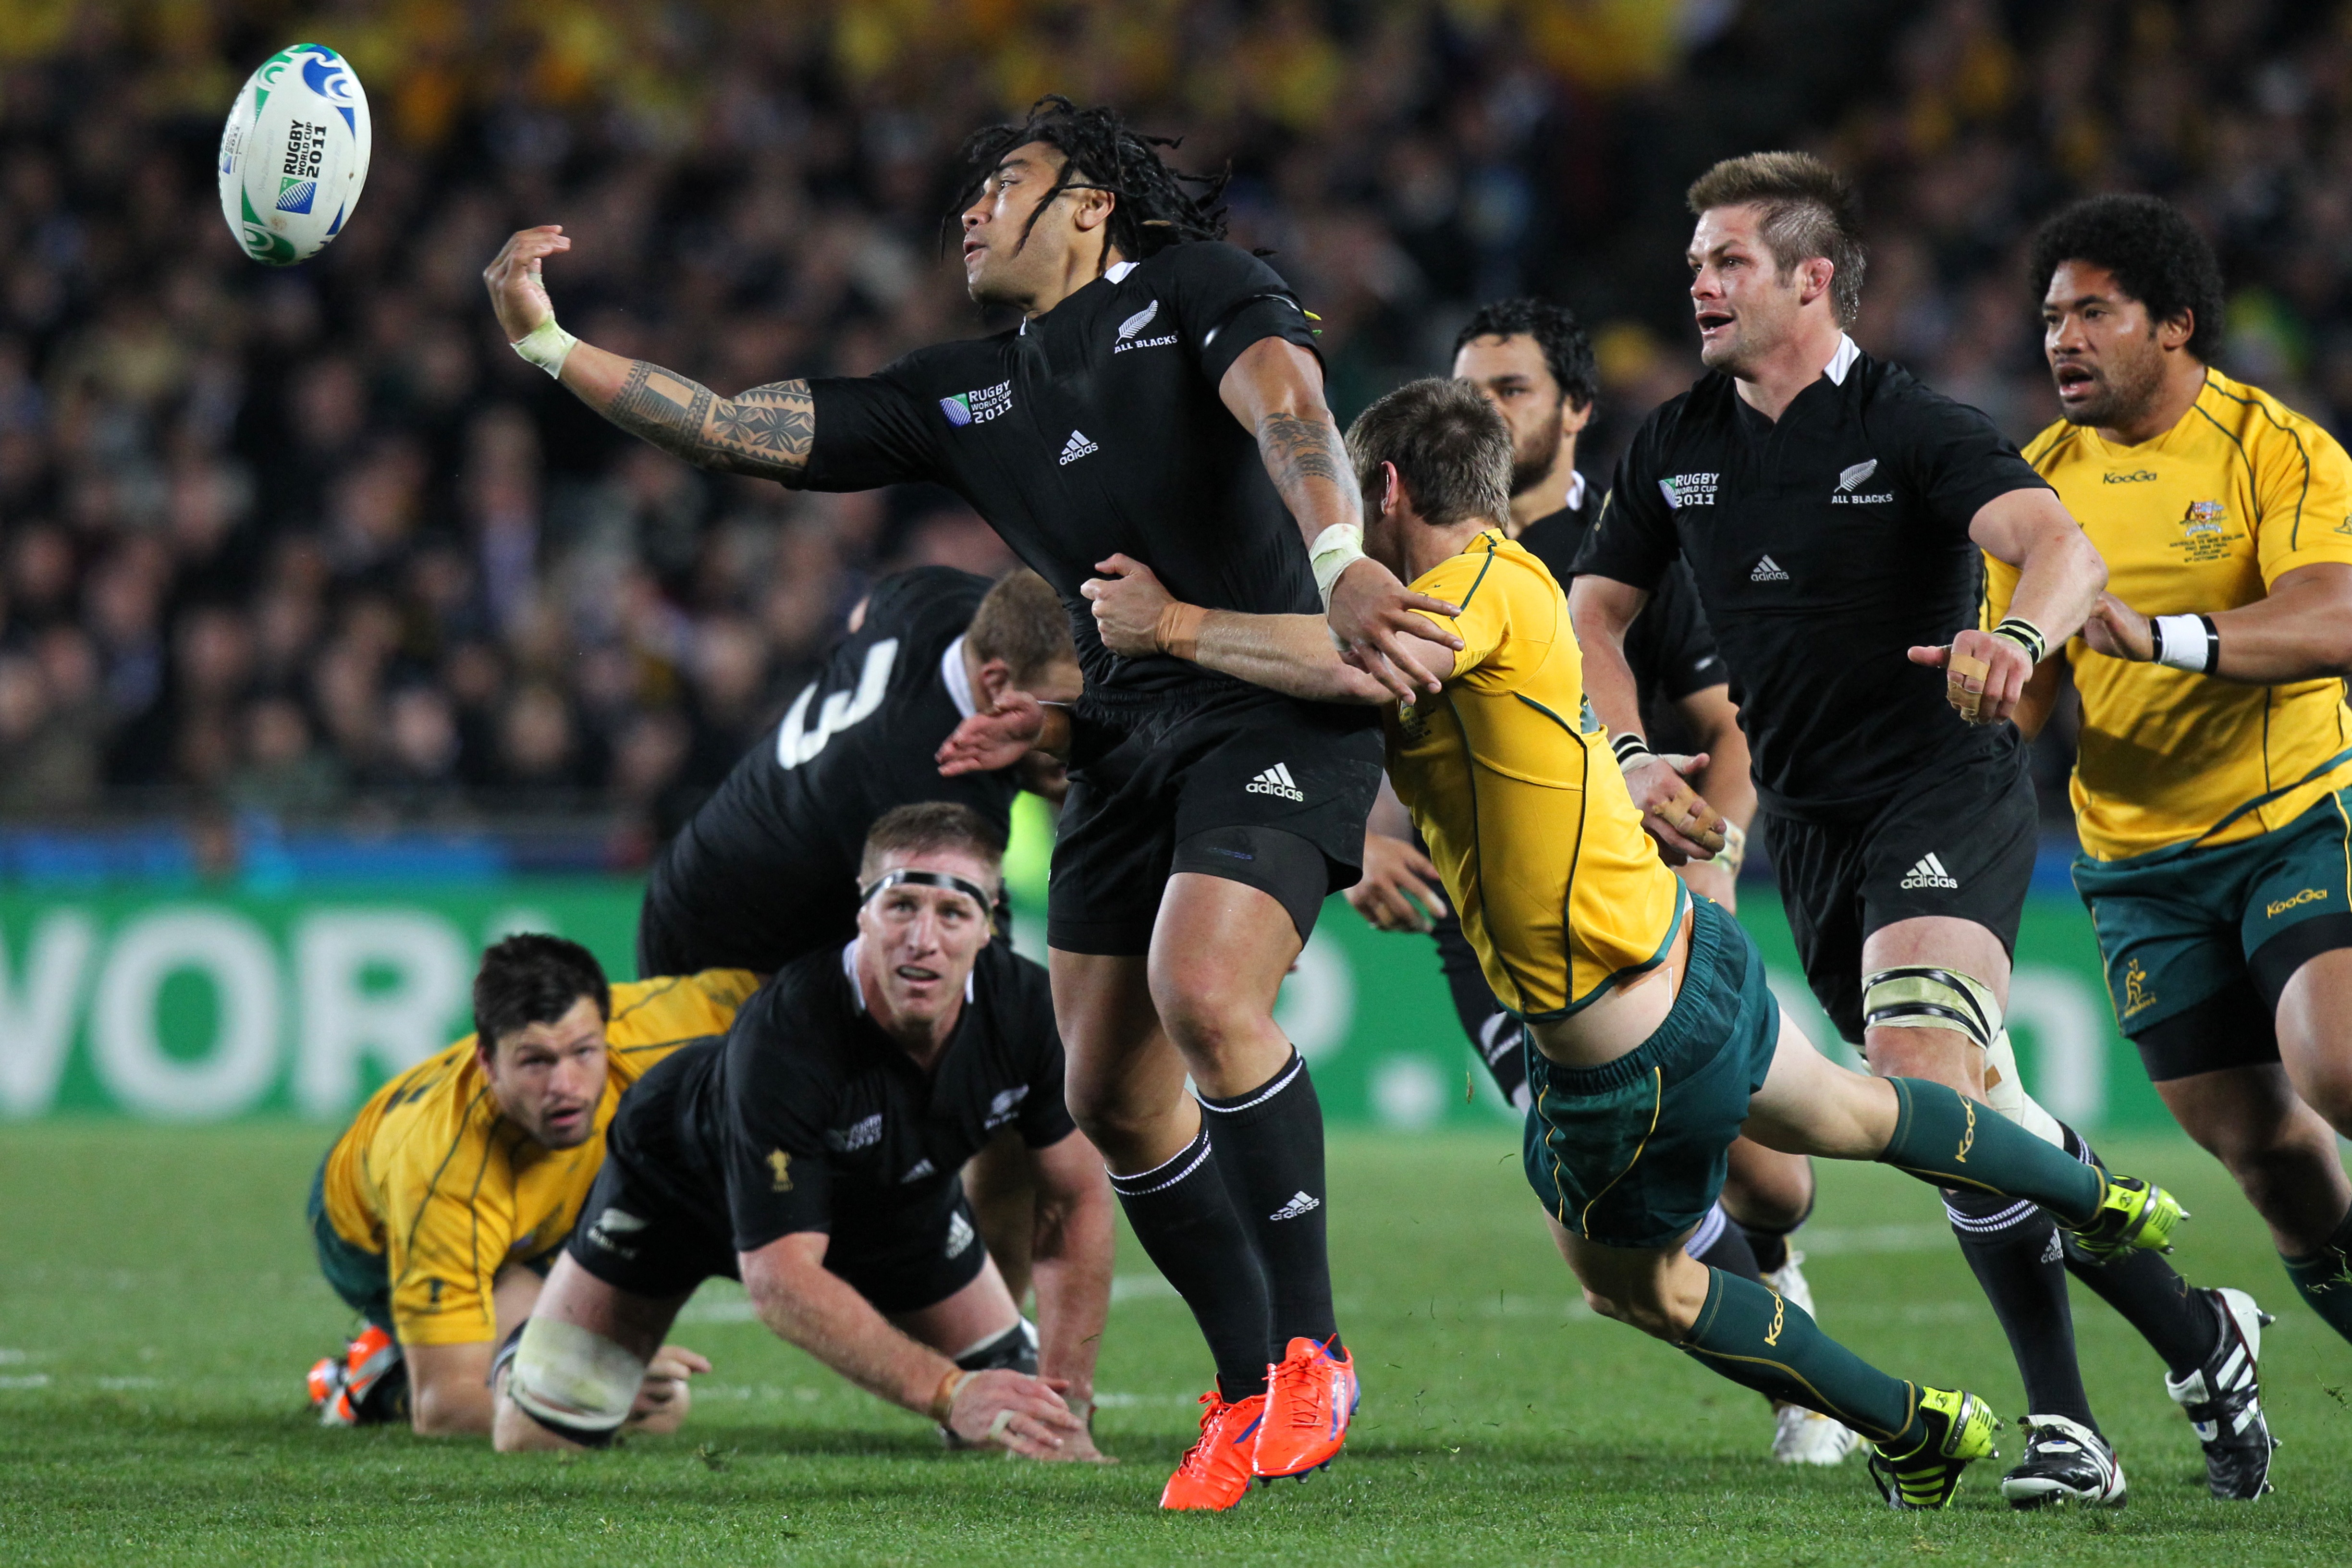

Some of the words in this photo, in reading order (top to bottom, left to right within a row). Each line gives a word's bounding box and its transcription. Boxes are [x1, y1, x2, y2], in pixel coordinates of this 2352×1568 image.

[283, 119, 304, 175] RUGBY
[297, 142, 310, 175] WORLD
[304, 122, 313, 140] CUP
[306, 126, 327, 178] 2011
[1114, 343, 1133, 354] ALL
[1135, 335, 1177, 348] BLACKS
[968, 380, 1010, 403] RUGBY
[971, 398, 997, 411] WORLD
[998, 390, 1012, 402] CUP
[972, 398, 1013, 424] 2011
[1059, 442, 1099, 466] adidas
[1675, 473, 1720, 487] RUGBY
[1675, 486, 1699, 495] WORLD
[1675, 493, 1715, 508] 2011
[1832, 495, 1849, 504] ALL
[1851, 494, 1893, 504] BLACKS
[1751, 571, 1789, 581] adidas
[776, 637, 898, 770] 3
[1245, 781, 1304, 802] adidas
[1900, 873, 1958, 889] adidas
[1270, 1198, 1320, 1221] adidas
[2041, 1248, 2064, 1264] adid
